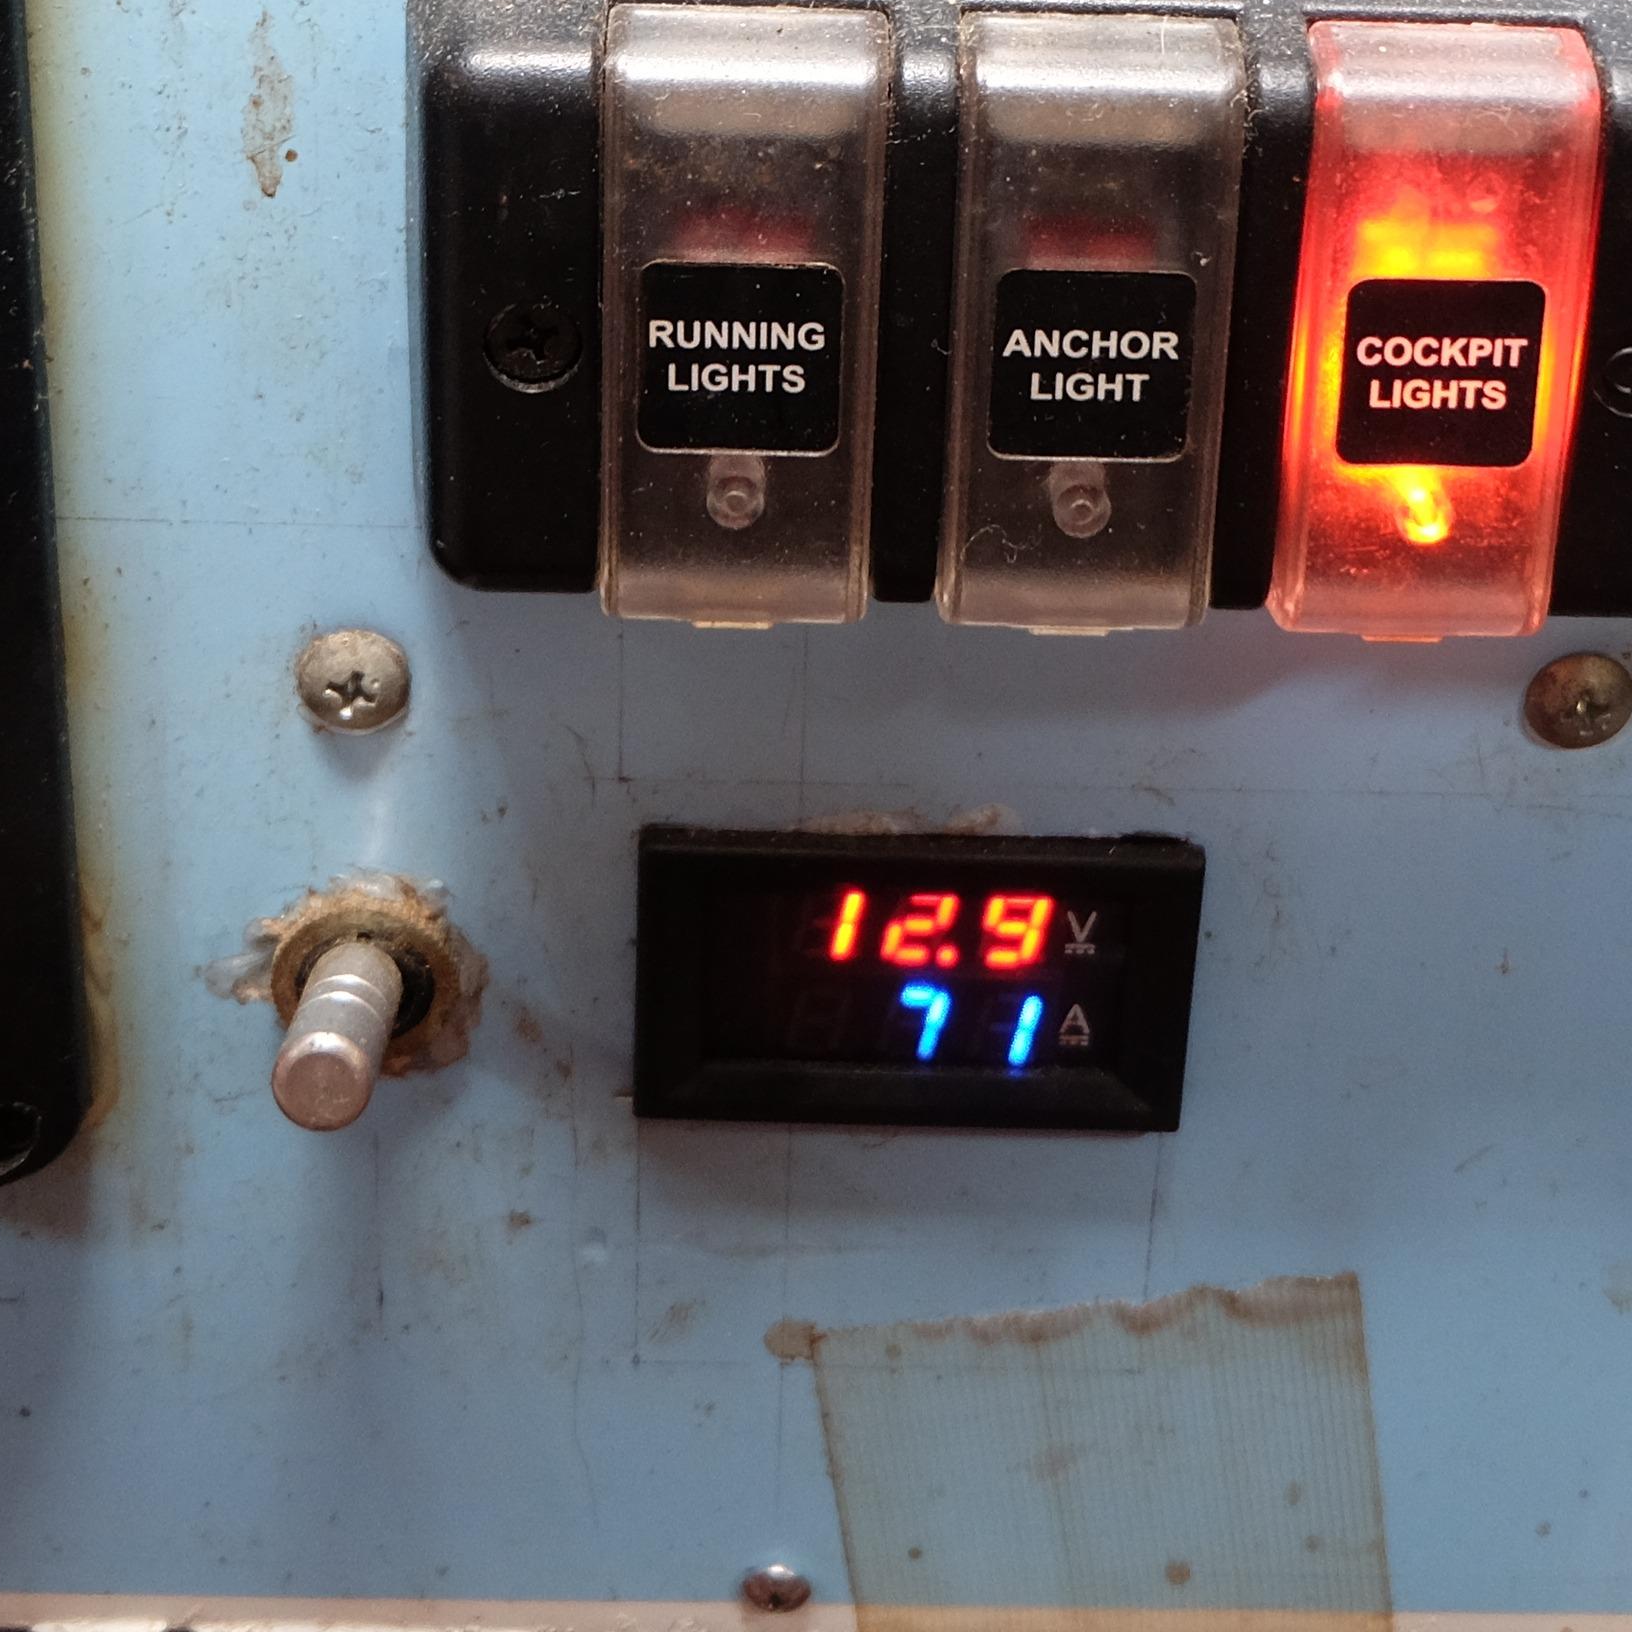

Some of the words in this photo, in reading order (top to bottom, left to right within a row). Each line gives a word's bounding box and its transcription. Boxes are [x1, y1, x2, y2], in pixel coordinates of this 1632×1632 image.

[648, 318, 826, 352] RUNNING
[1001, 328, 1180, 361] ANCHOR
[1355, 335, 1530, 369] COCKPIT
[667, 362, 807, 395] LIGHTS
[1029, 371, 1151, 403] LIGHT
[1368, 378, 1508, 411] LIGHTS
[827, 889, 1056, 970] 12.9
[1066, 910, 1098, 943] V
[1059, 1004, 1091, 1036] A
